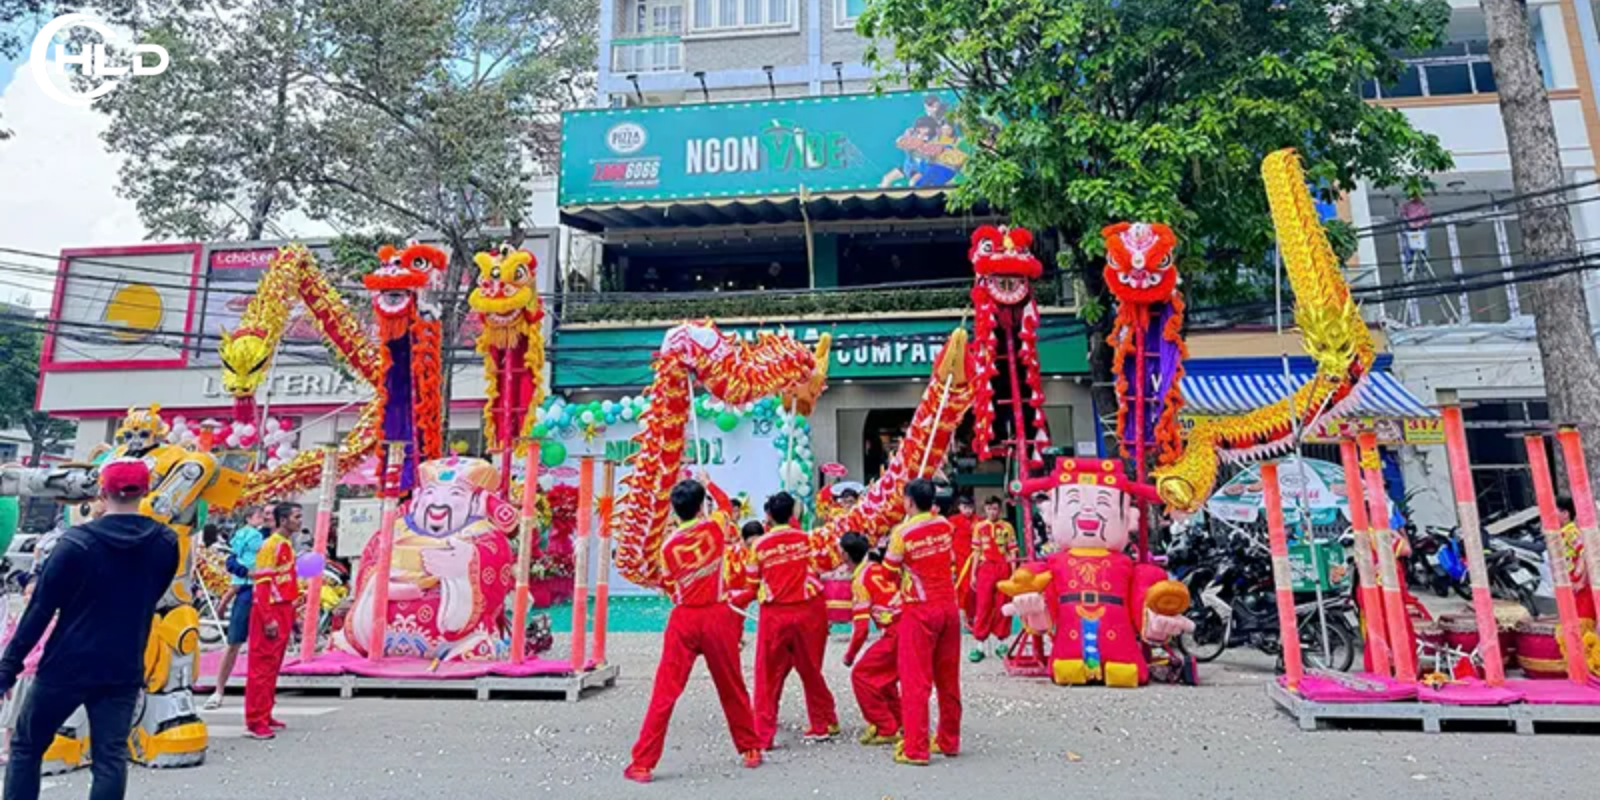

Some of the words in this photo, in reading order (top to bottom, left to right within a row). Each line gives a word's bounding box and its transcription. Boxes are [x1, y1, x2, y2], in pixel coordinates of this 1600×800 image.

[687, 136, 758, 174] NGON
[836, 332, 946, 364] COMPAN
[203, 373, 356, 398] LTERIA
[1408, 419, 1439, 430] 317
